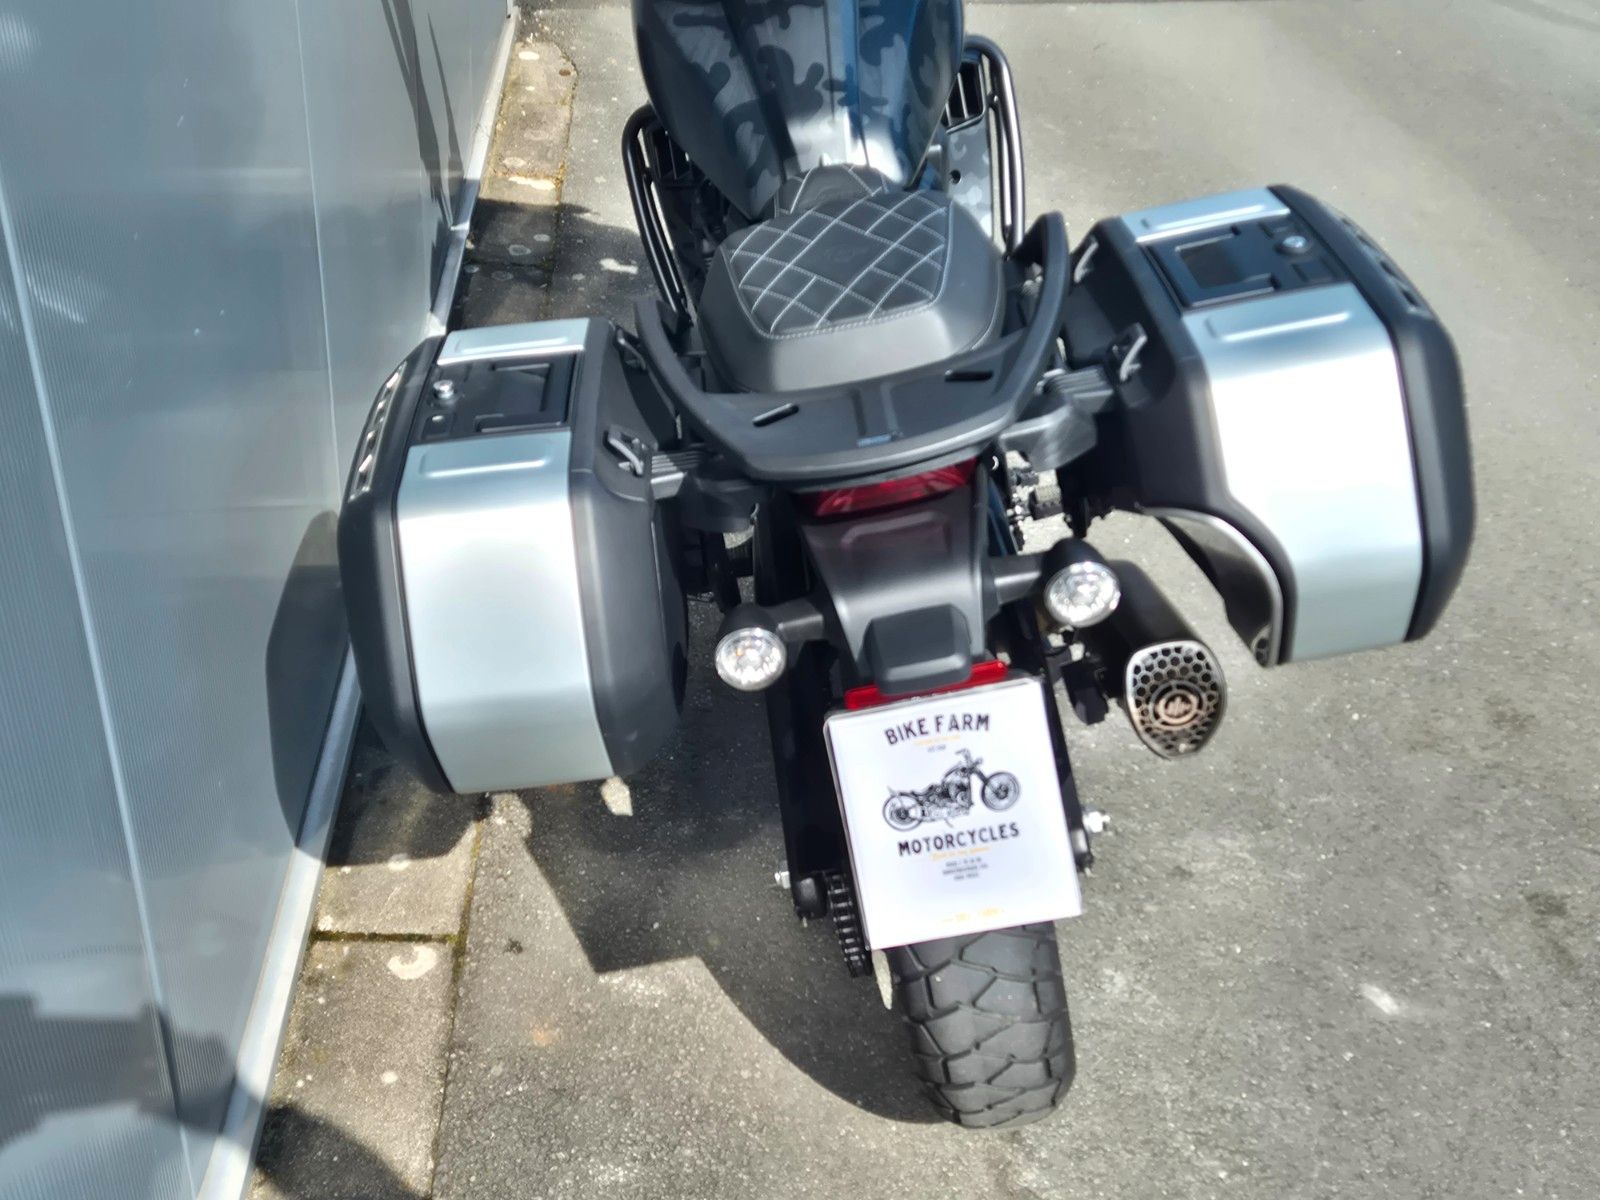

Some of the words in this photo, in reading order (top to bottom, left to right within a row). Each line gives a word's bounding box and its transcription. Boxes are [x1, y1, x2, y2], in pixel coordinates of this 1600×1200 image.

[884, 717, 930, 746] BIKE
[936, 713, 990, 733] FARM
[897, 822, 1020, 857] MOTORCYCLES
